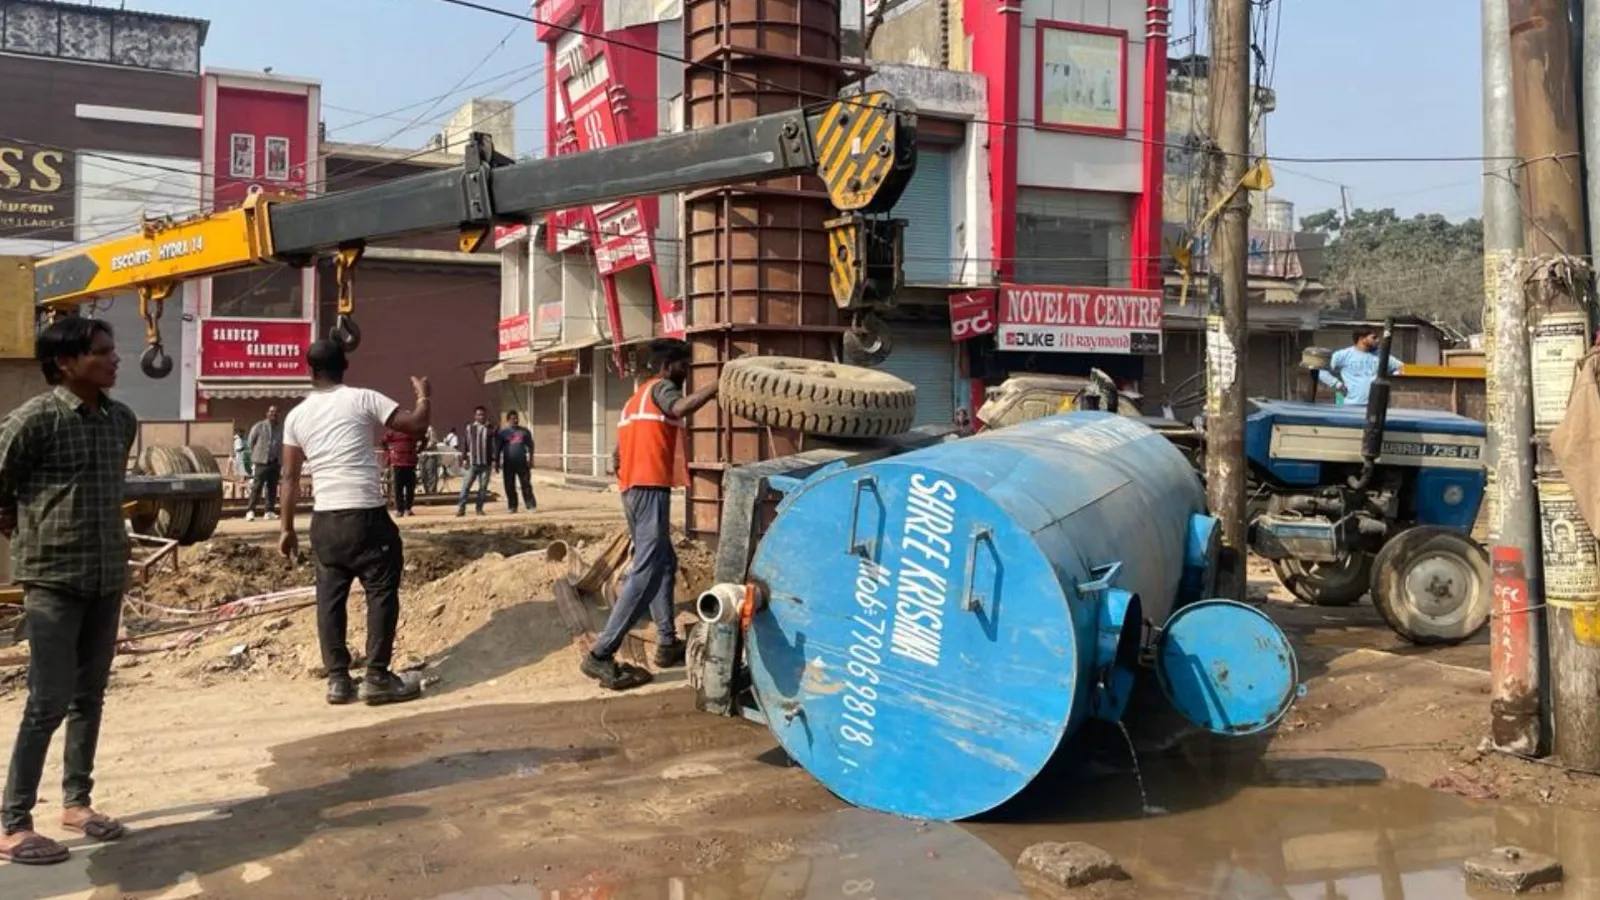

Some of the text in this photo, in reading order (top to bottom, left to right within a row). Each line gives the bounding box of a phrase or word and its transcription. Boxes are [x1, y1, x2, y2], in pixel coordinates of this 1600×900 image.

[112, 249, 152, 271] ESCORTS
[159, 240, 189, 259] HYDRA
[1007, 290, 1091, 324] NOVELTY
[1094, 295, 1161, 327] CENTRE
[213, 328, 259, 341] SANDEEP
[1017, 332, 1055, 347] DUKE
[246, 343, 299, 356] GARMENTS
[213, 361, 244, 369] LADIES
[249, 361, 273, 369] WEAR
[1432, 445, 1457, 457] 735
[1461, 446, 1479, 459] FE
[890, 473, 957, 667] SHREE KRISHNA
